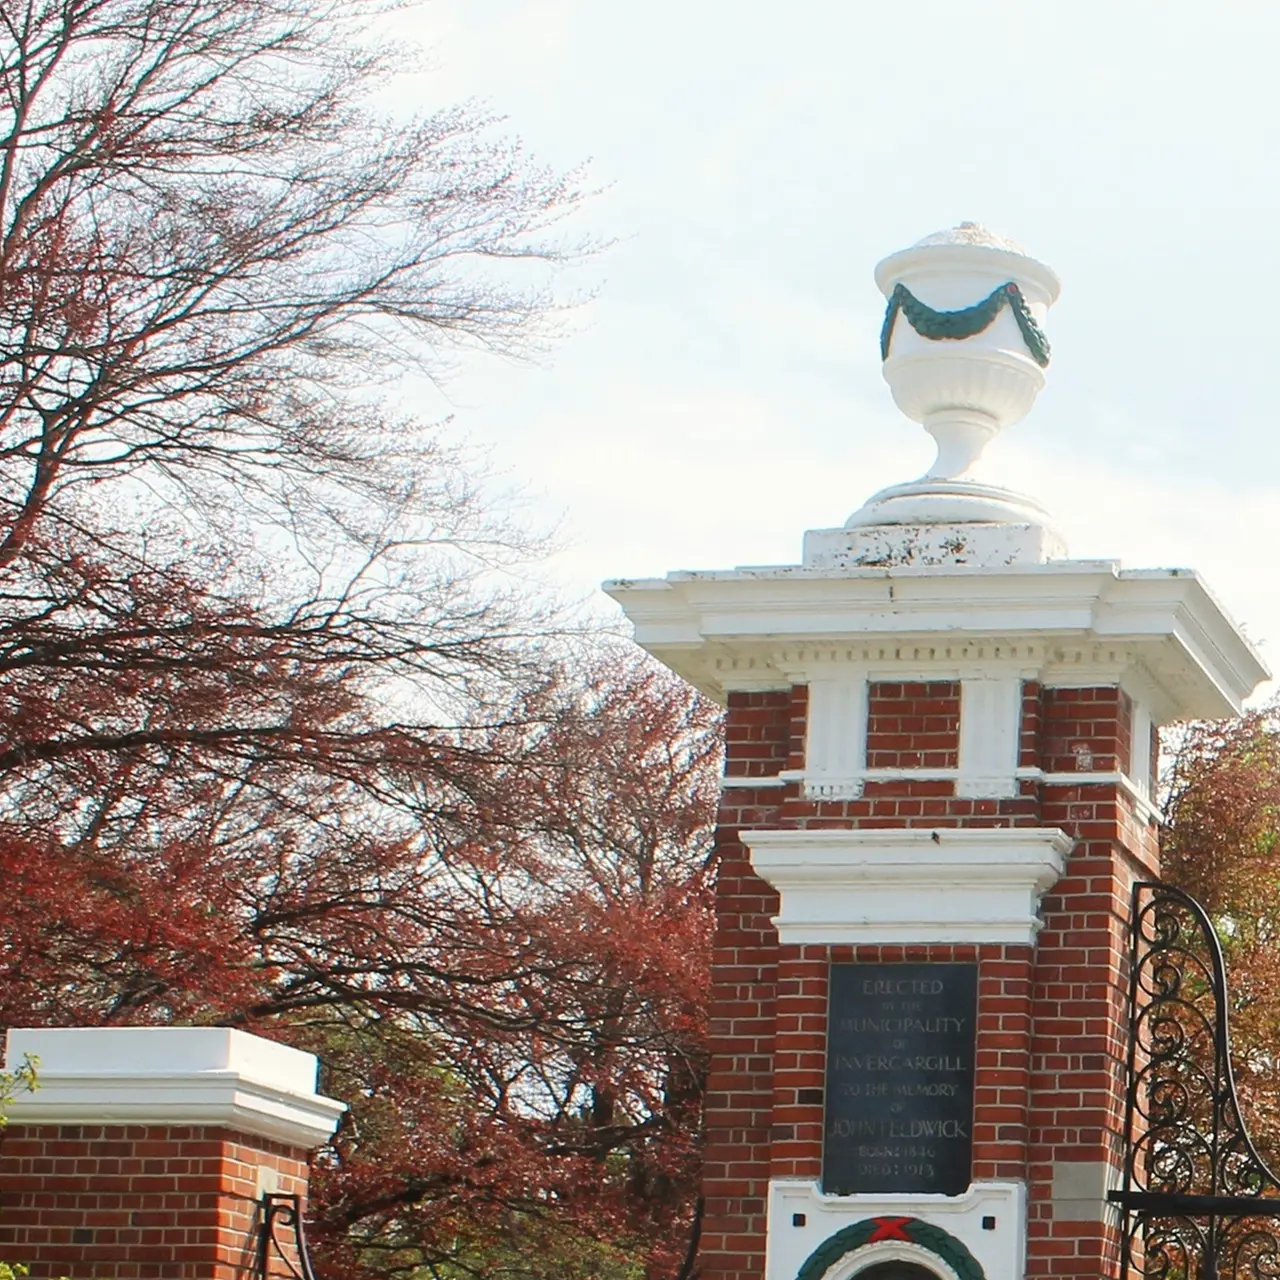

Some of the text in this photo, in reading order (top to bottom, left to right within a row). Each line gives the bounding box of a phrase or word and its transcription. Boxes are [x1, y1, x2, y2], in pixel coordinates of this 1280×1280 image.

[863, 980, 944, 995] ERECTED
[840, 1017, 966, 1033] MUNICIPALITY
[835, 1055, 967, 1071] INVERCARGILL
[840, 1083, 959, 1097] TO THE MEMORY
[828, 1119, 969, 1139] JOHN FELDWICK
